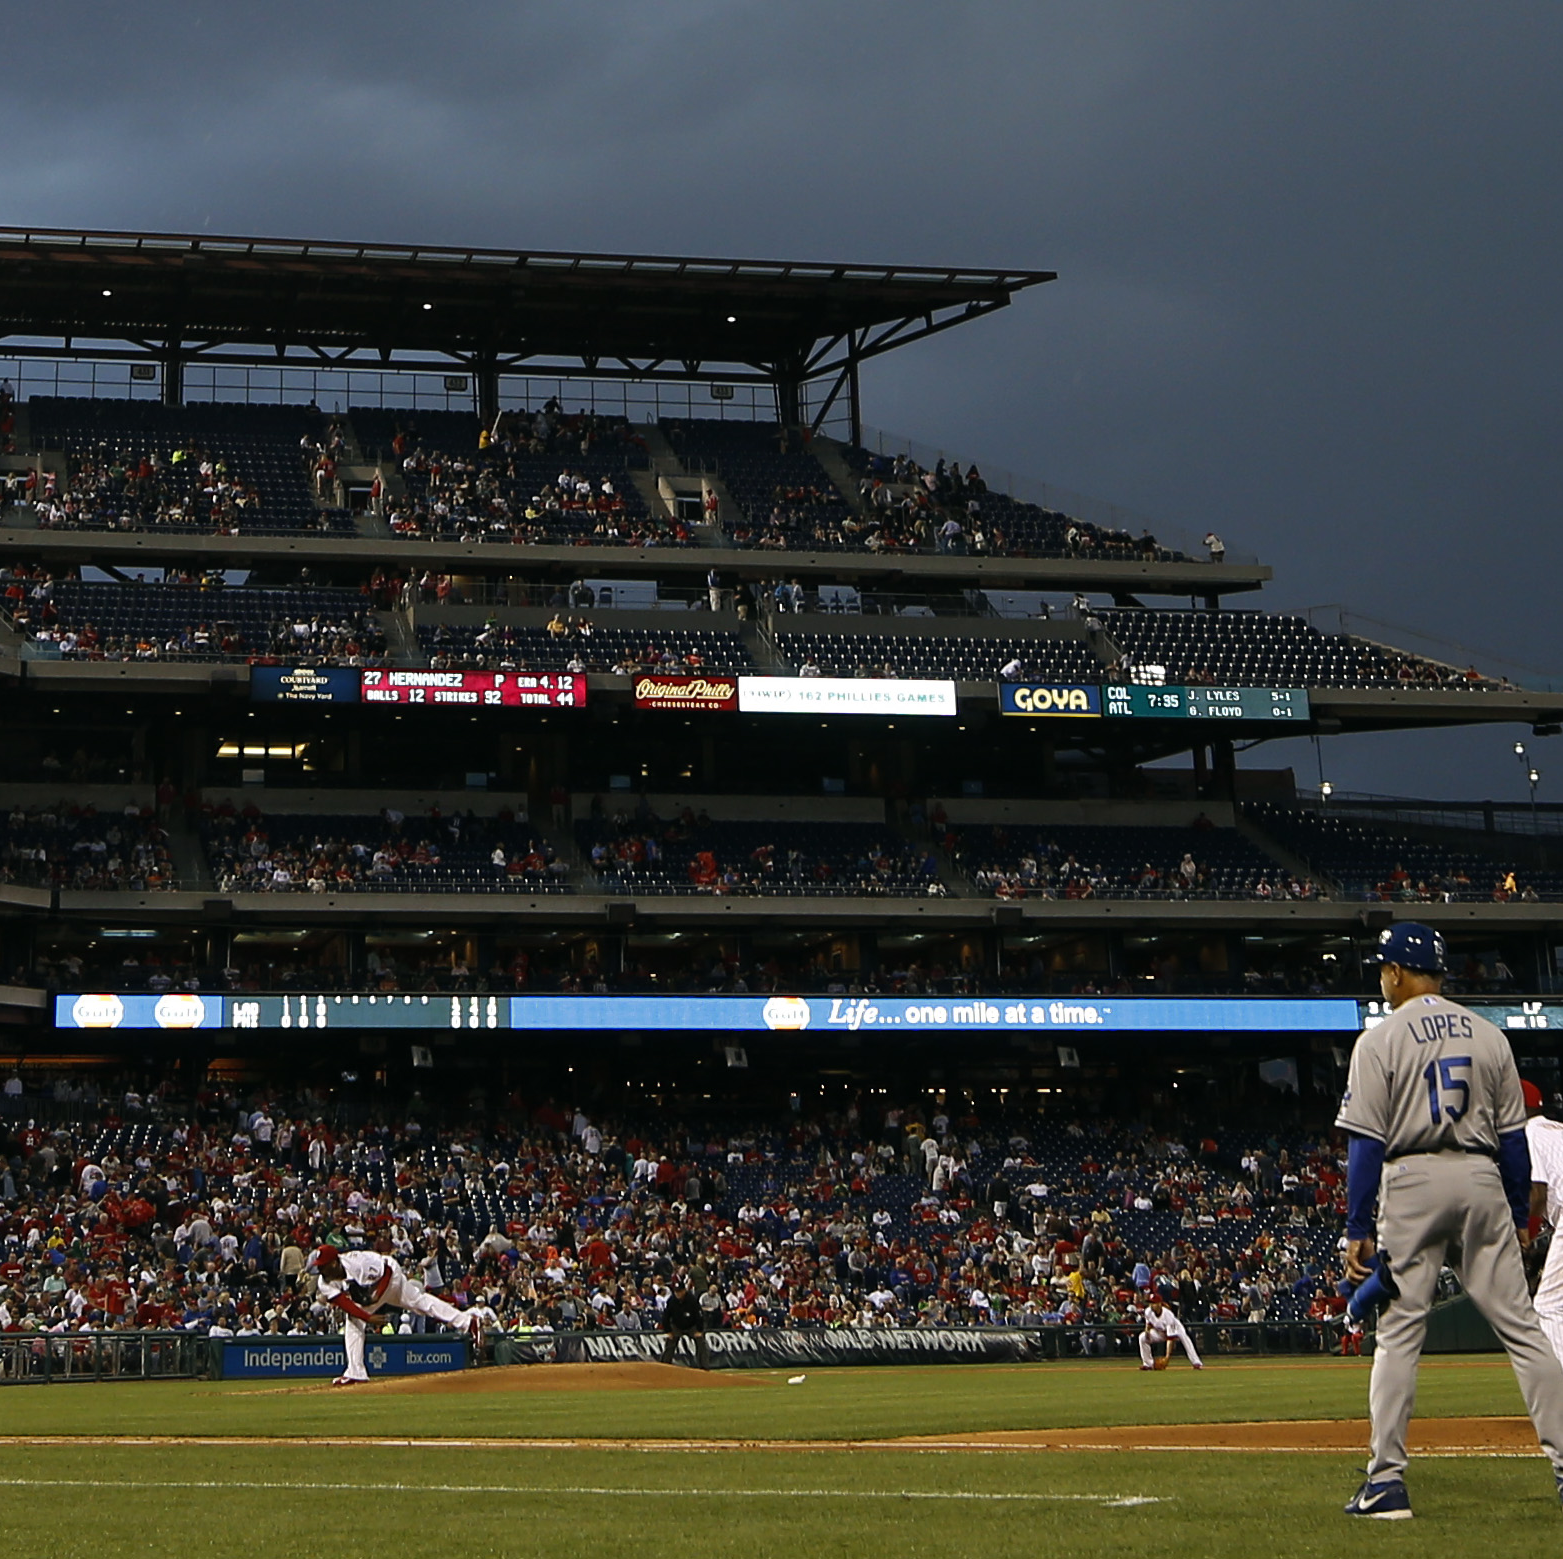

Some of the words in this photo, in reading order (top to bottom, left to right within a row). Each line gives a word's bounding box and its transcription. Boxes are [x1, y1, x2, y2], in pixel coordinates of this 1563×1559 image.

[281, 676, 328, 684] COURTYARD
[364, 672, 381, 685] 27
[389, 672, 463, 687] HERNANDEZ
[495, 674, 504, 687] P
[518, 677, 536, 687] ERA
[540, 676, 573, 690] 4.12
[636, 679, 695, 700] Original
[691, 680, 735, 700] Philly
[1108, 687, 1131, 699] COL
[1187, 691, 1199, 701] J.
[1206, 691, 1239, 701] LYLES
[1271, 692, 1290, 701] 5-1
[367, 690, 399, 701] BALLS
[409, 689, 424, 702] 12
[434, 691, 477, 703] STRIKES
[521, 693, 551, 704] TOTAL
[557, 693, 573, 706] 44
[798, 691, 822, 702] 162
[828, 692, 891, 702] PHILLIES
[897, 693, 945, 703] GAMES
[1014, 688, 1087, 711] GOYA
[1148, 694, 1179, 707] 7:35
[1109, 702, 1133, 715] ATL
[1209, 706, 1242, 717] FLOYD
[78, 1007, 117, 1017] Gulf
[160, 1007, 198, 1017] Gulf
[905, 1004, 947, 1024] one
[953, 1001, 999, 1024] mile
[1005, 1004, 1027, 1023] at
[1031, 1005, 1045, 1023] a
[1049, 1001, 1103, 1024] time.
[1407, 1015, 1473, 1044] LOPES
[1423, 1056, 1472, 1124] 15
[584, 1336, 638, 1357] MLB
[881, 1329, 986, 1352] NETWORK
[406, 1350, 451, 1364] ibx.com
